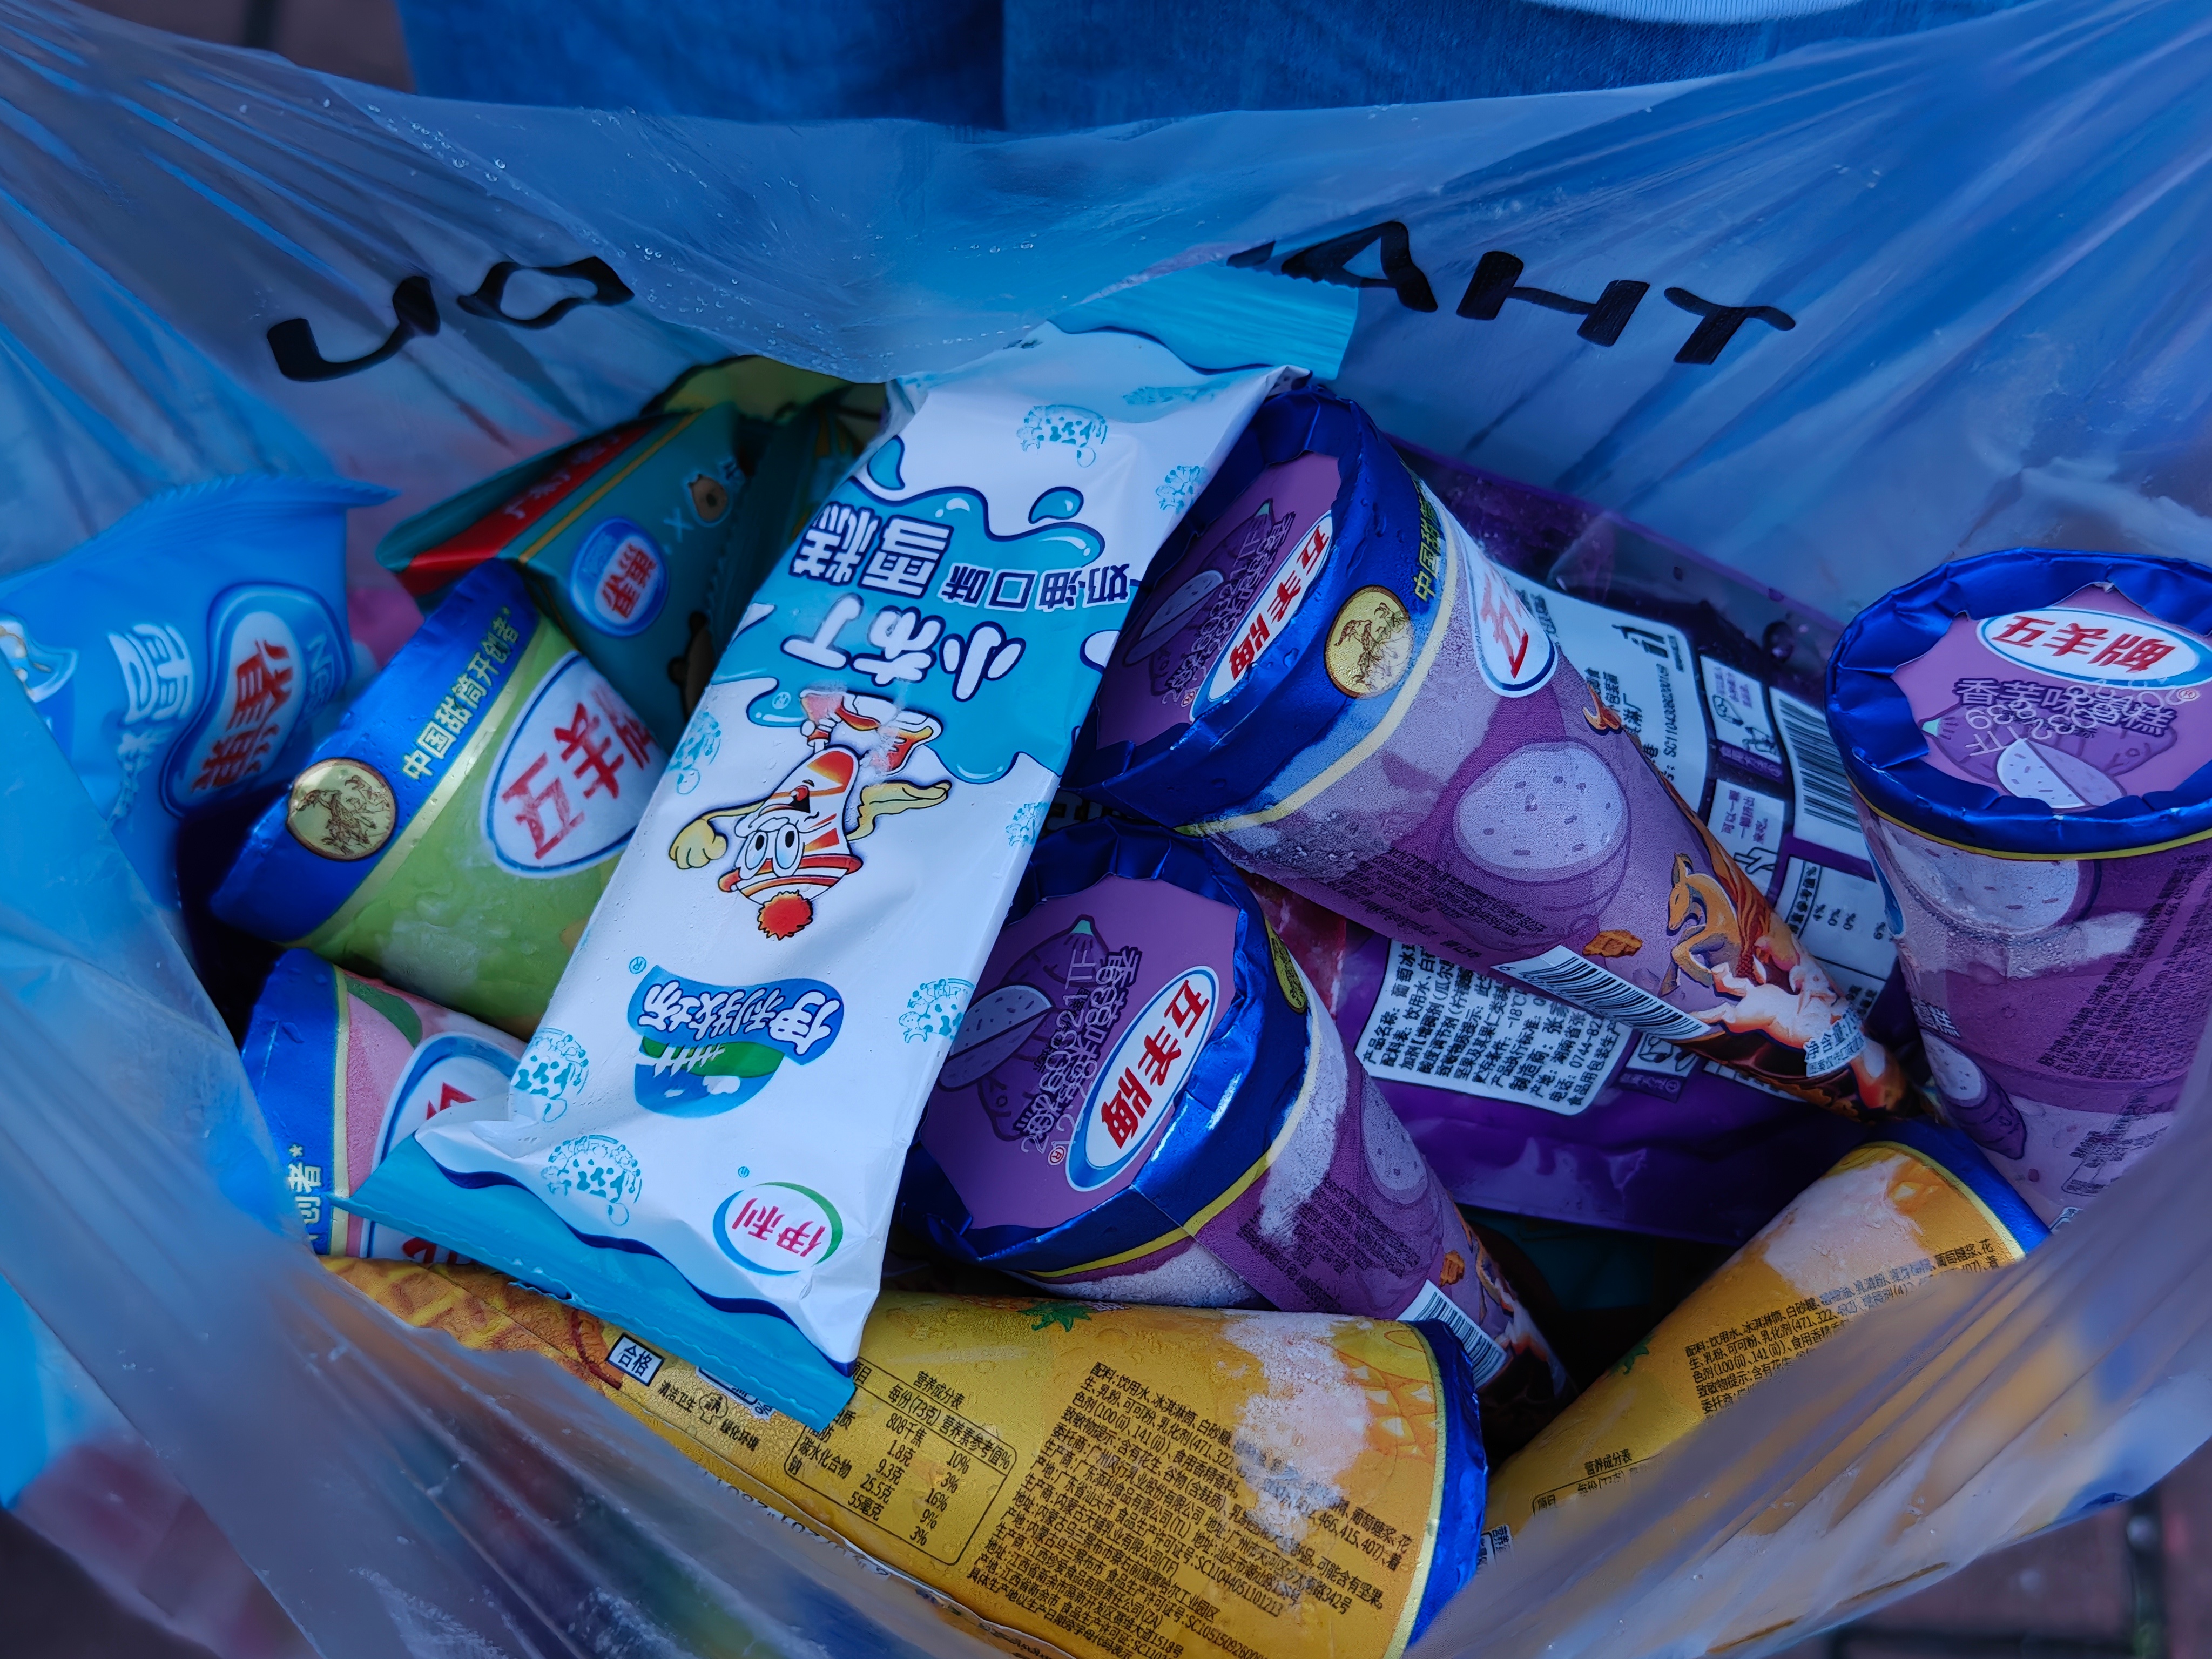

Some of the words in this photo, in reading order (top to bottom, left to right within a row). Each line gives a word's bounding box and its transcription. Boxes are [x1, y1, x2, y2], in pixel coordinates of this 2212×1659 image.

[790, 502, 954, 598] 雪糕
[942, 563, 1132, 611] 奶油口味
[1230, 526, 1331, 679] 五羊牌
[781, 593, 1026, 701] 小布丁
[1991, 615, 2175, 673] 五羊牌
[191, 638, 295, 795] 雀巢
[639, 980, 840, 1055] 伊利牧场
[1568, 1013, 1605, 1068] 0744-82
[1100, 979, 1210, 1150] 五羊牌
[731, 1197, 826, 1257] 伊利
[616, 1340, 655, 1378] 合格
[656, 1380, 698, 1414] 清洁卫生
[912, 1370, 966, 1411] 营养成分表
[885, 1382, 942, 1428] 每份(73克)
[938, 1413, 1014, 1471] 营养素参考值%
[885, 1412, 927, 1448] 808千焦
[946, 1449, 973, 1475] 10%
[796, 1436, 853, 1480] 碳水化合物
[858, 1472, 896, 1504] 25.5克
[918, 1508, 941, 1531] 9%
[873, 1457, 906, 1486] 9.3克
[923, 1486, 952, 1513] 16%
[885, 1439, 917, 1468] 1.8克
[939, 1471, 962, 1494] 3%
[1584, 1448, 1633, 1475] 营养成分表
[786, 1456, 804, 1476] 钠
[845, 1489, 886, 1522] 55毫克
[908, 1524, 932, 1547] 3%
